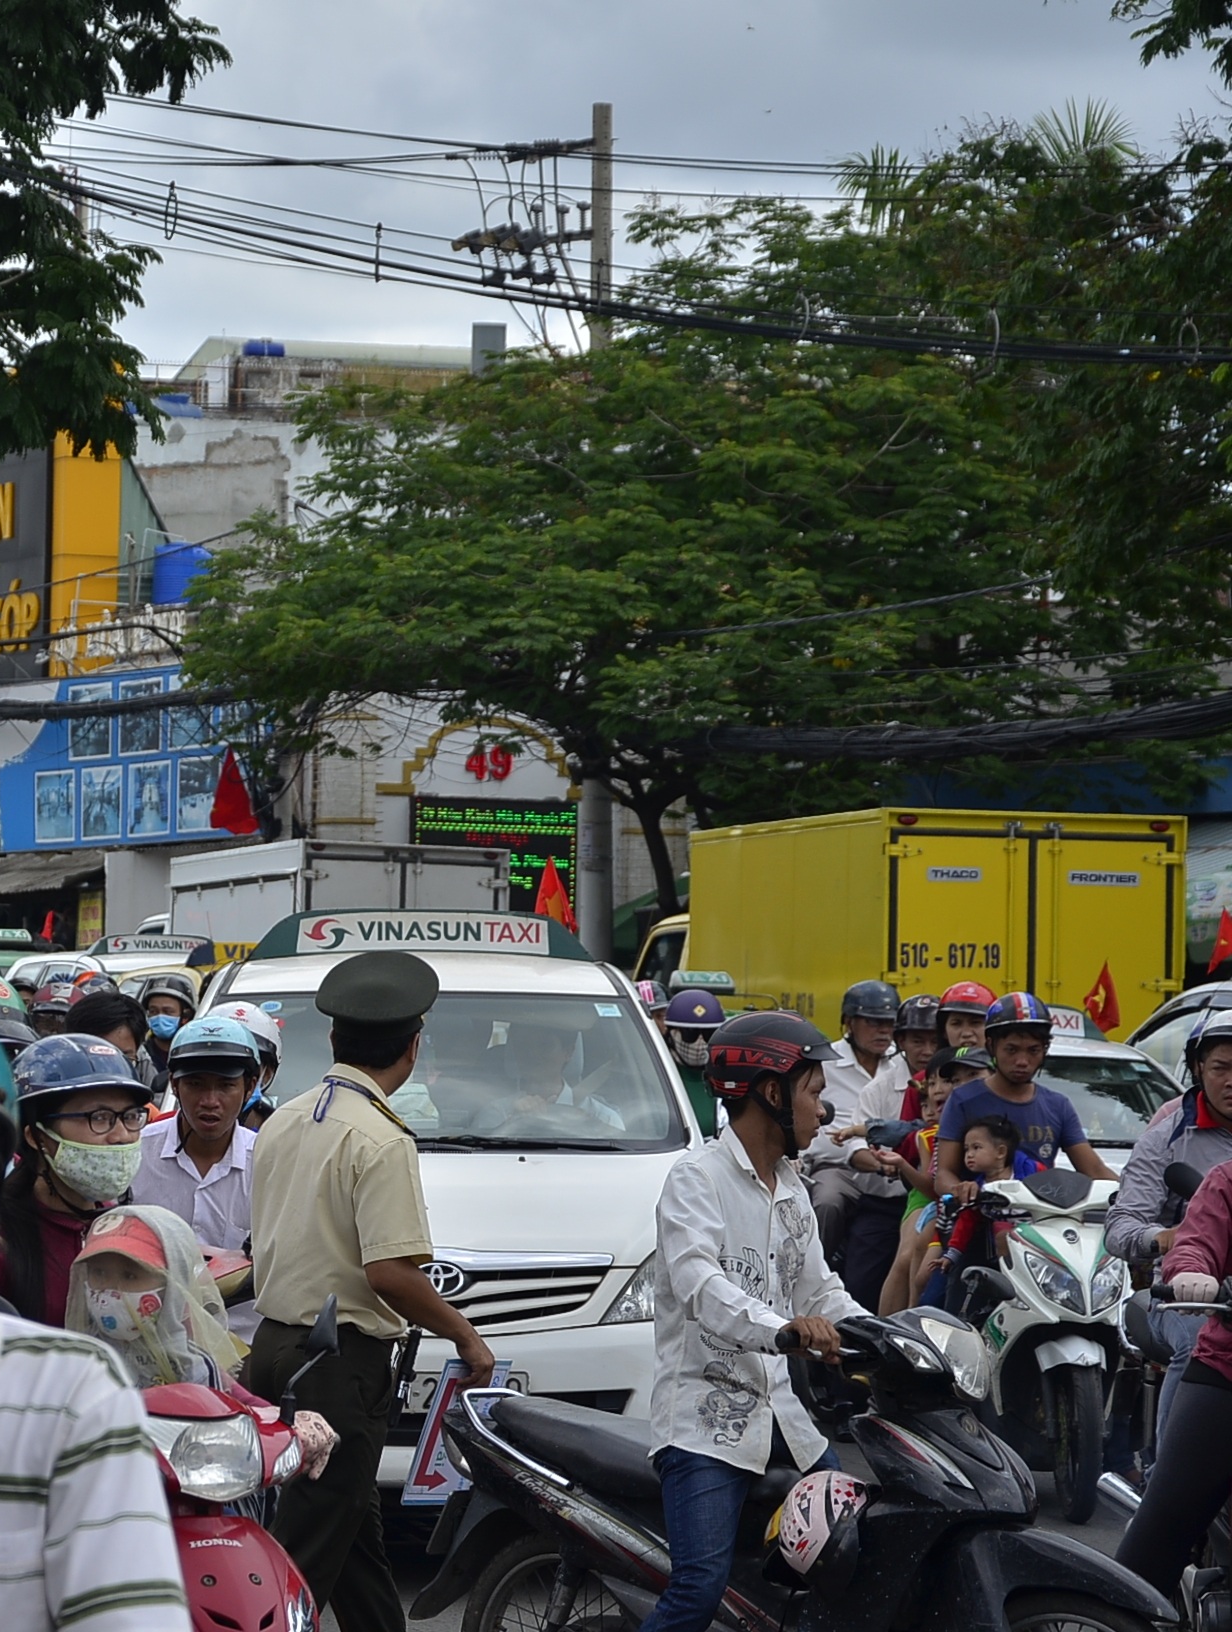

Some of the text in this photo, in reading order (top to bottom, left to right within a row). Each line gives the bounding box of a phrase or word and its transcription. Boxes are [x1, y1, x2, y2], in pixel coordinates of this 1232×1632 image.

[465, 744, 514, 781] 49
[931, 868, 980, 880] THACO
[1070, 872, 1138, 883] FRONTIER
[900, 943, 929, 968] 51C
[948, 943, 1001, 969] 617.19
[1052, 1014, 1079, 1030] AXI
[189, 1538, 243, 1549] HONDA
